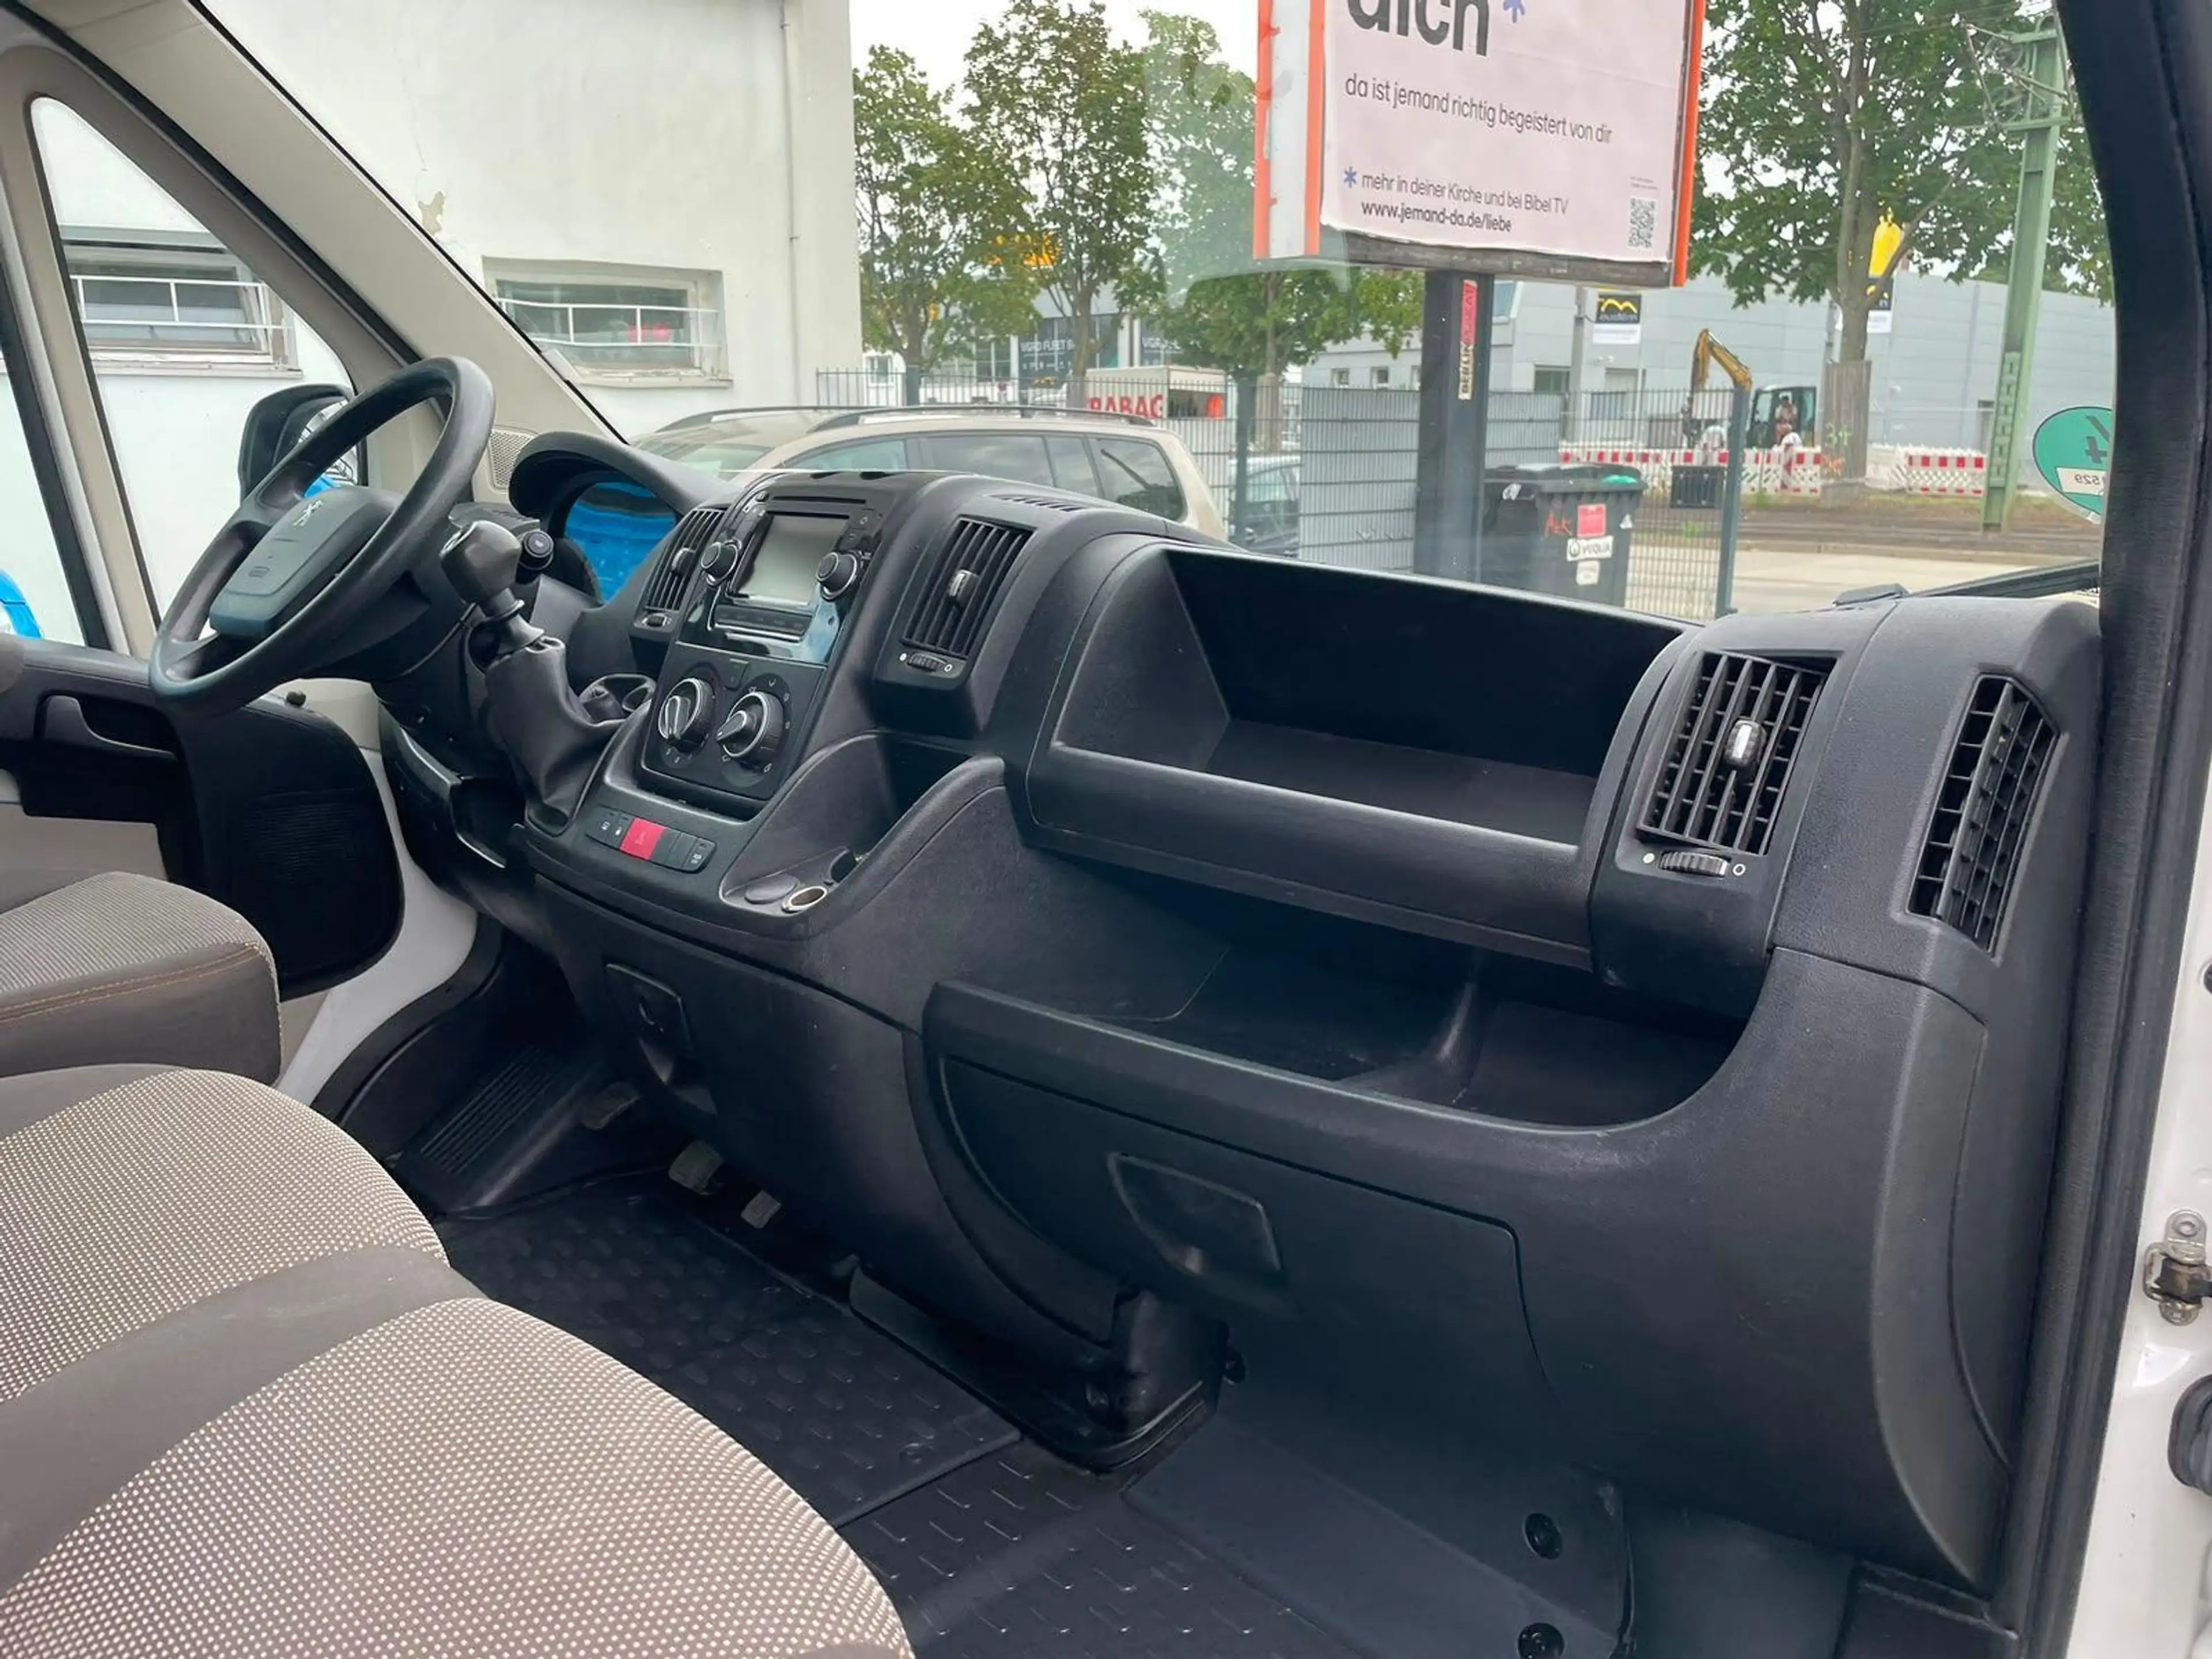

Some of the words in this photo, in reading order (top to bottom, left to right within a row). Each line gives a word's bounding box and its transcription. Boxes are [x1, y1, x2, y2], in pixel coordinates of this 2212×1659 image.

[1345, 73, 1368, 97] da
[1372, 77, 1390, 101] ist
[1392, 81, 1449, 113] jemand
[1452, 96, 1496, 128] richtig
[1499, 103, 1567, 134] begeistert
[1569, 122, 1593, 141] von
[1595, 123, 1612, 143] dir
[1362, 173, 1395, 191] mehr
[1396, 175, 1408, 194] in
[1410, 177, 1446, 198] deiner
[1448, 183, 1482, 204] Kirche
[1484, 190, 1505, 207] und
[1507, 190, 1522, 209] bei
[1524, 194, 1551, 213] Bibel
[1554, 197, 1569, 215] TV
[1361, 202, 1512, 232] www.jemand-da.de/liebe
